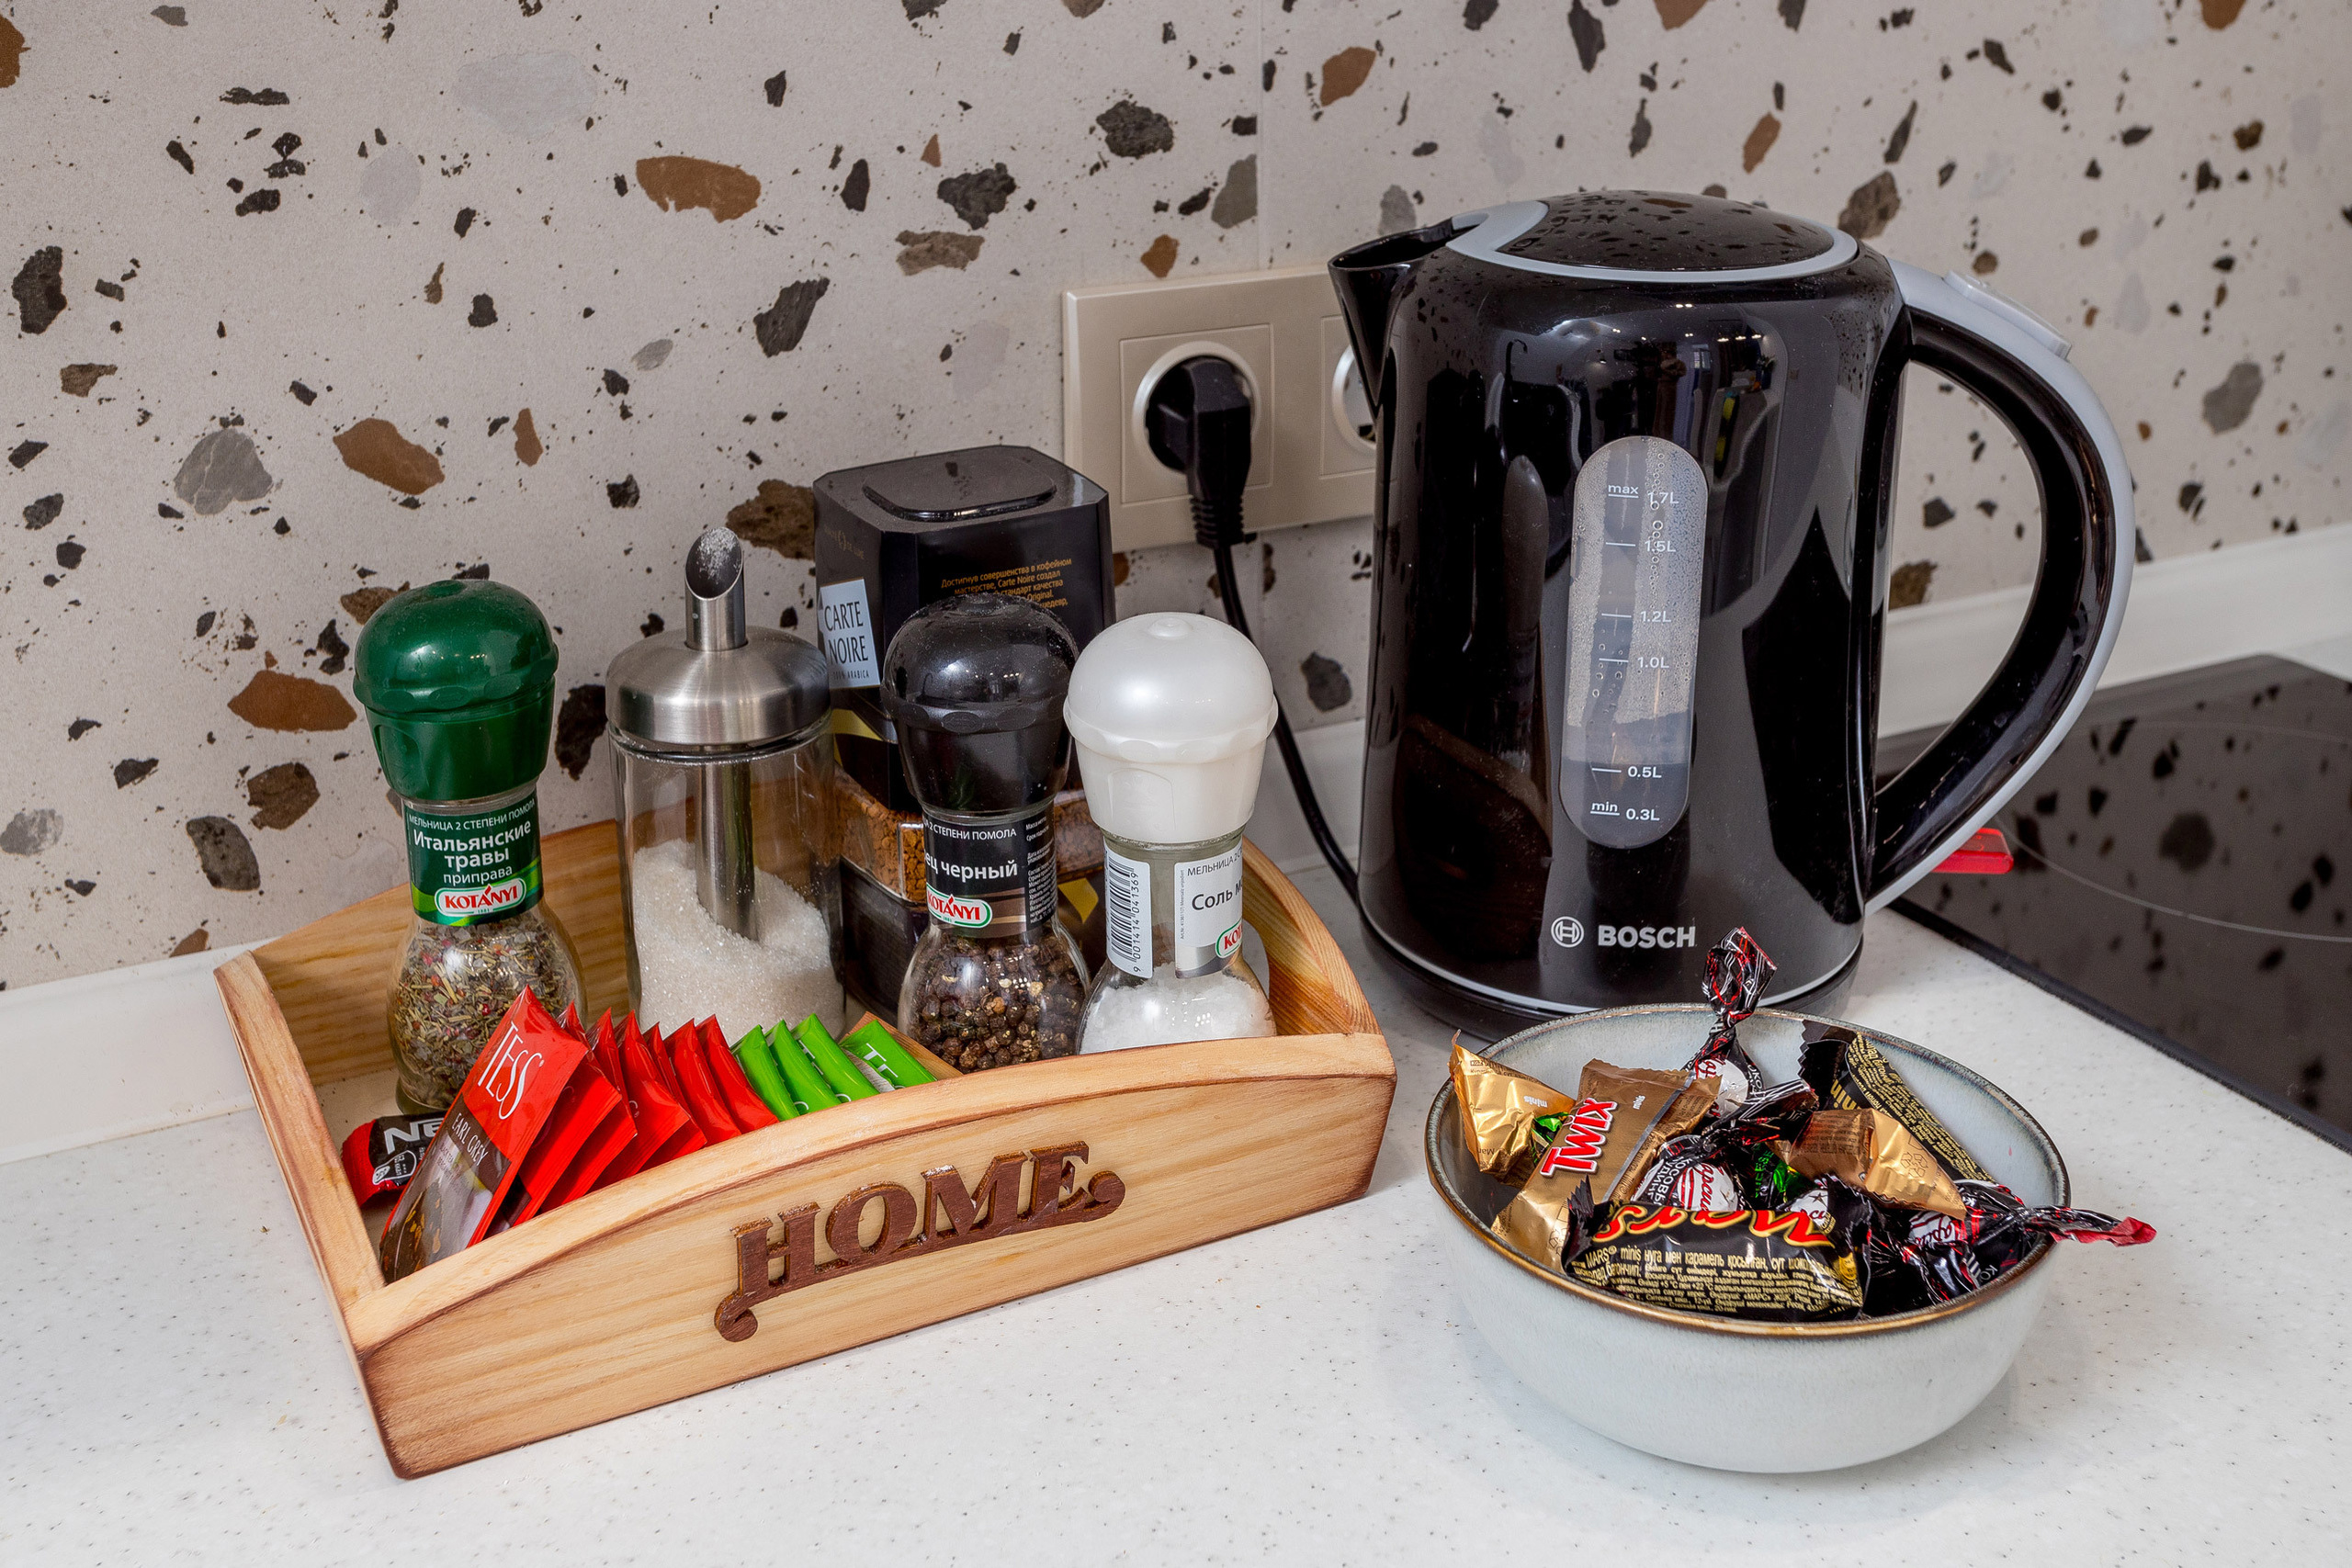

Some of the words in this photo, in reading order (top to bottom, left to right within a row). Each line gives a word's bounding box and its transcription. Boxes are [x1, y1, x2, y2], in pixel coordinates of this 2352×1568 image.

[1607, 482, 1639, 494] max
[1647, 491, 1679, 505] 1.7L
[1644, 539, 1676, 553] 1.5L
[941, 576, 978, 589] Достигнув
[980, 566, 1029, 582] совершенства
[1036, 558, 1072, 571] кофейном
[998, 578, 1016, 591] Carte
[1017, 575, 1035, 587] Noire
[1036, 570, 1061, 581] создал
[1033, 579, 1064, 591] качества
[824, 601, 864, 631] CARTE
[1639, 610, 1672, 623] 1.2L
[828, 636, 868, 665] NOIRE
[847, 670, 870, 680] ARABICA
[1637, 657, 1669, 670] 1.0L
[1627, 765, 1662, 779] 0.5L
[409, 814, 454, 831] МЕЛЬНИЦА
[456, 821, 462, 830] 2
[463, 815, 507, 829] СТЕПЕНИ
[508, 798, 536, 820] ПОМОЛА
[1591, 800, 1618, 812] min
[1625, 808, 1660, 821] 0.3L
[413, 820, 531, 852] Итальянские
[933, 824, 970, 840] СТЕПЕНИ
[972, 828, 1017, 840] ПОМОЛА
[444, 848, 509, 873] травы
[941, 860, 1017, 883] черный
[1187, 858, 1234, 876] МЕЛЬНИЦА
[443, 865, 513, 886] приправа
[1131, 873, 1140, 914] 041369
[1192, 889, 1233, 910] Соль
[1132, 919, 1141, 960] 001414
[1598, 925, 1696, 949] BOSCH
[477, 1021, 542, 1120] TESS
[451, 1112, 471, 1145] EARL
[468, 1134, 489, 1166] GREY
[722, 1140, 1102, 1303] HOME
[1621, 1245, 1642, 1261] minis
[1665, 1251, 1682, 1264] мен
[1685, 1252, 1724, 1268] карамель
